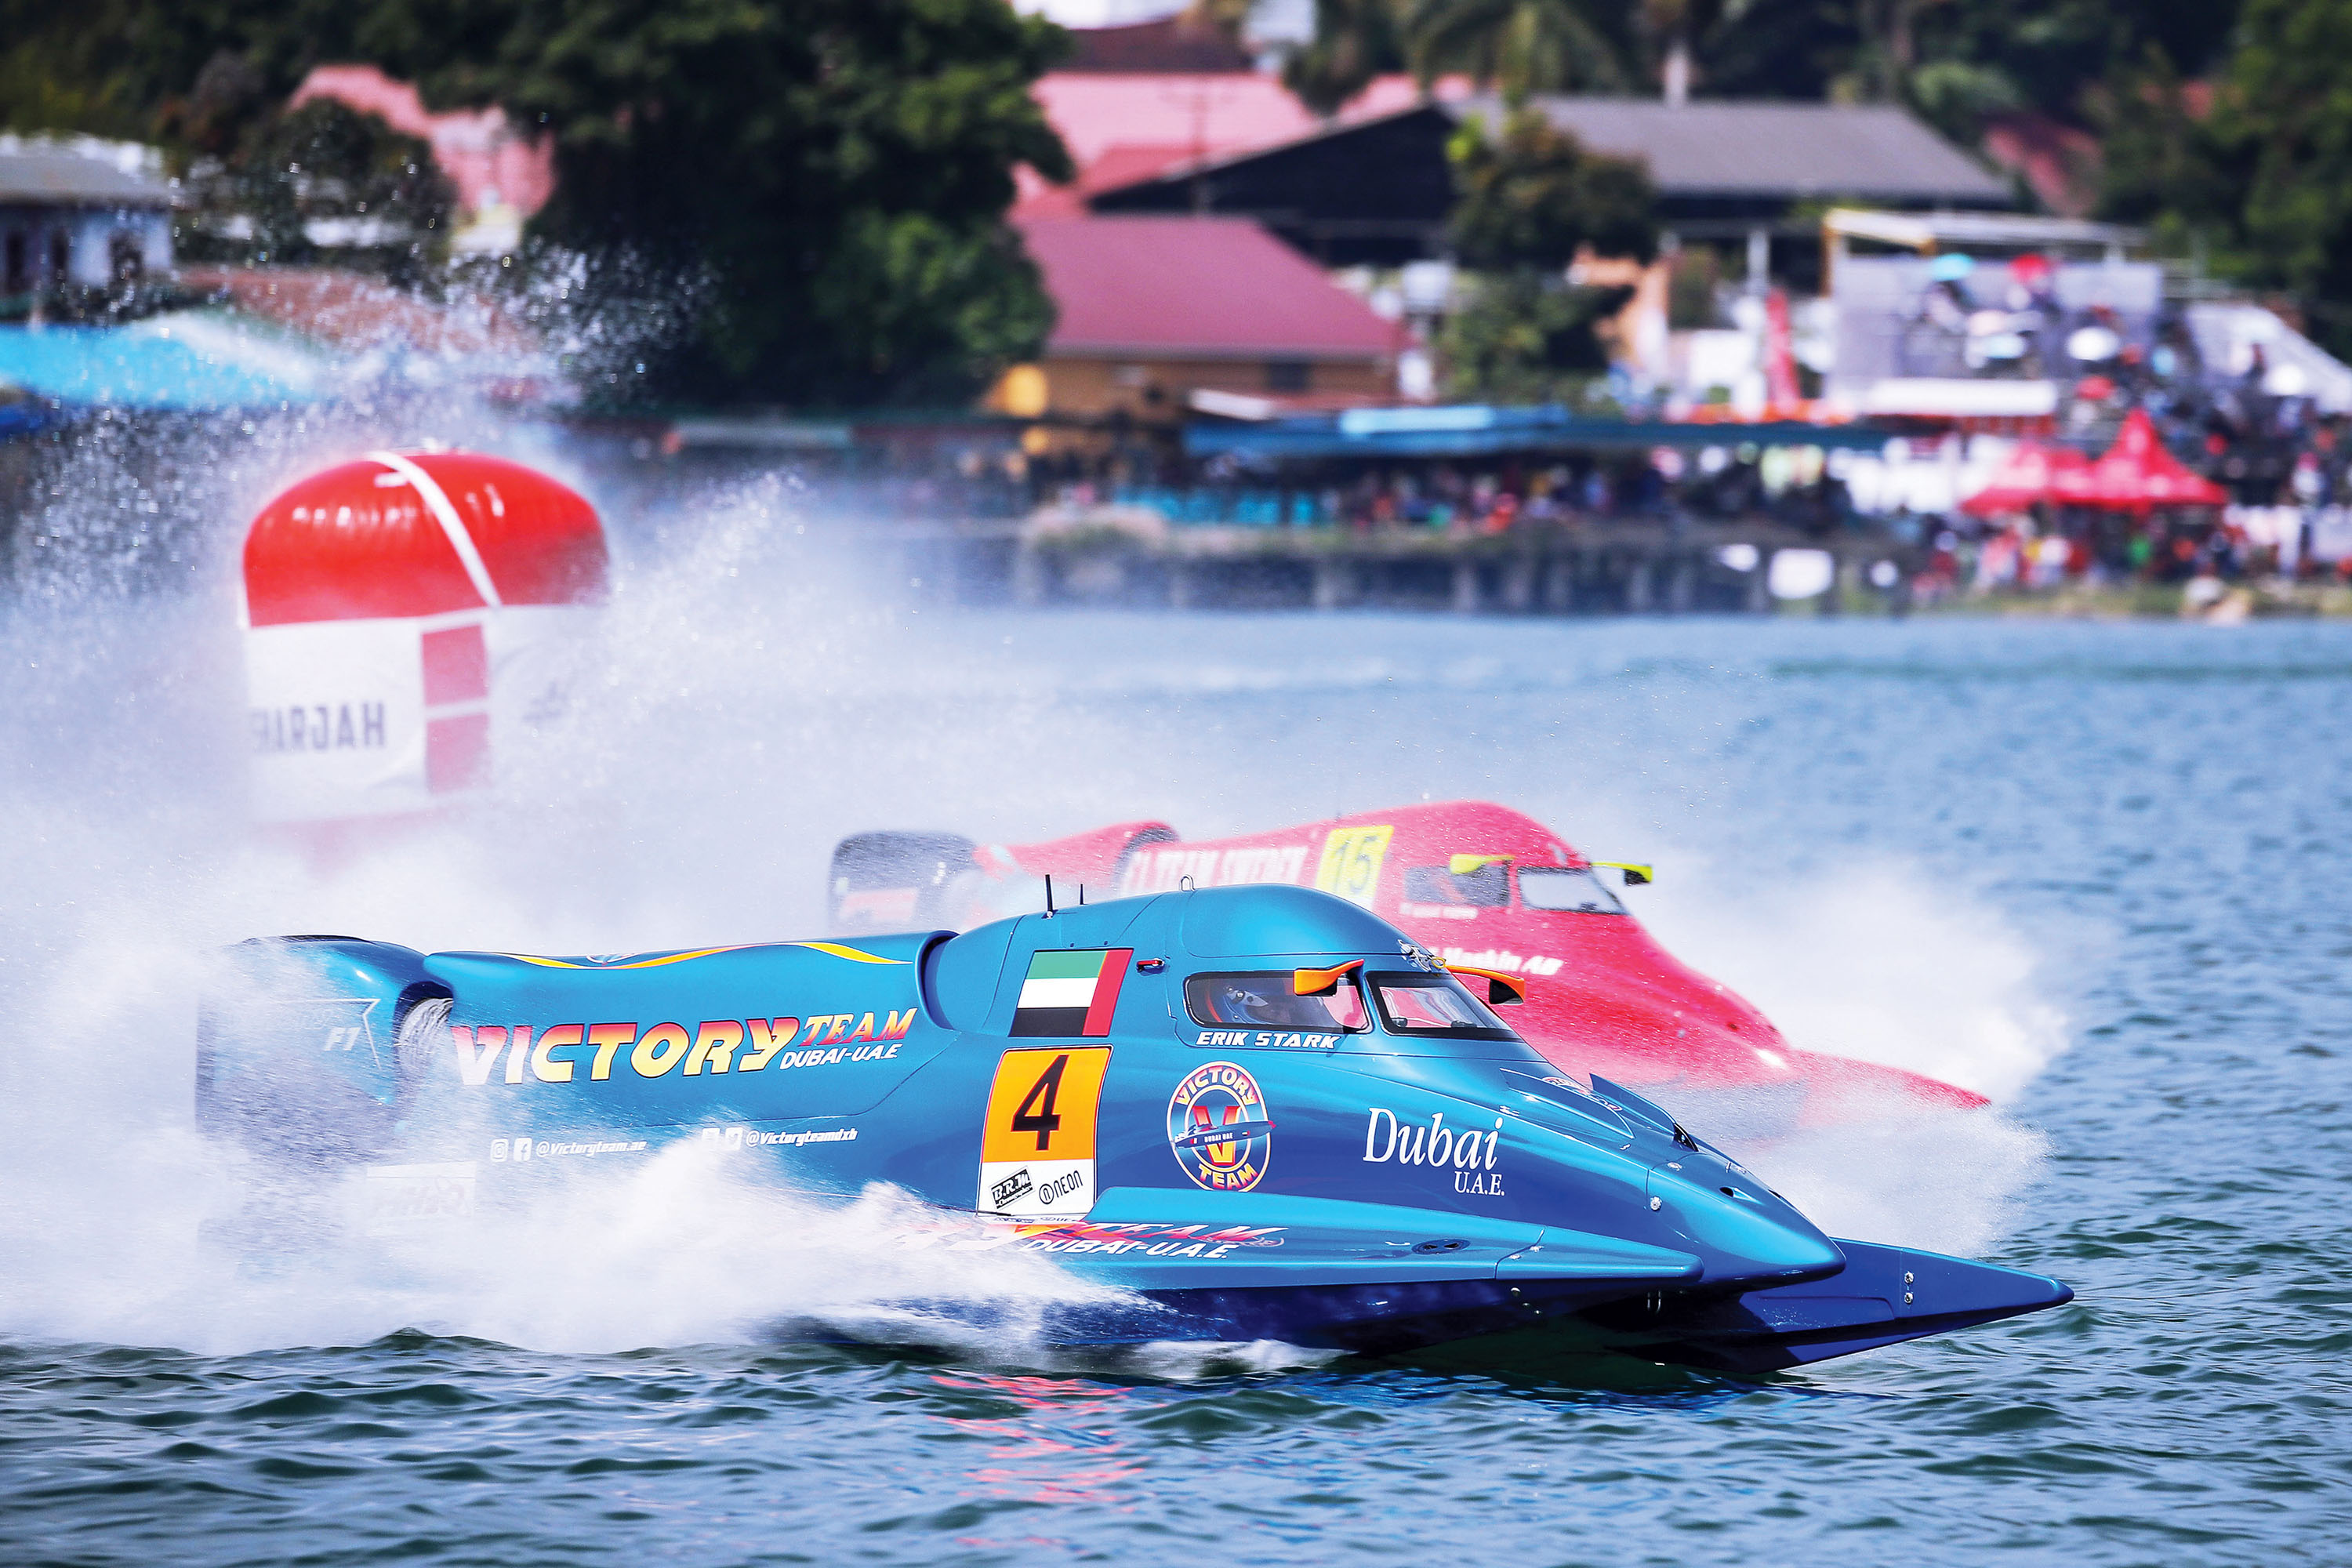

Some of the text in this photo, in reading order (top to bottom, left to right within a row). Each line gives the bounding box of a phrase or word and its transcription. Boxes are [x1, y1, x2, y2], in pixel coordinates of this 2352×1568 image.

[1330, 834, 1380, 895] 15
[324, 1026, 361, 1051] F1
[450, 1007, 917, 1086] VICTORY TEAM
[1196, 1031, 1341, 1049] ERIK STARK
[1174, 1065, 1259, 1105] VICTORY
[1011, 1054, 1069, 1151] 4
[746, 1127, 858, 1147] @Victoryteamdxb
[1363, 1107, 1504, 1171] Dubai
[1198, 1163, 1258, 1190] TEAM
[1454, 1171, 1505, 1196] U.A.E.
